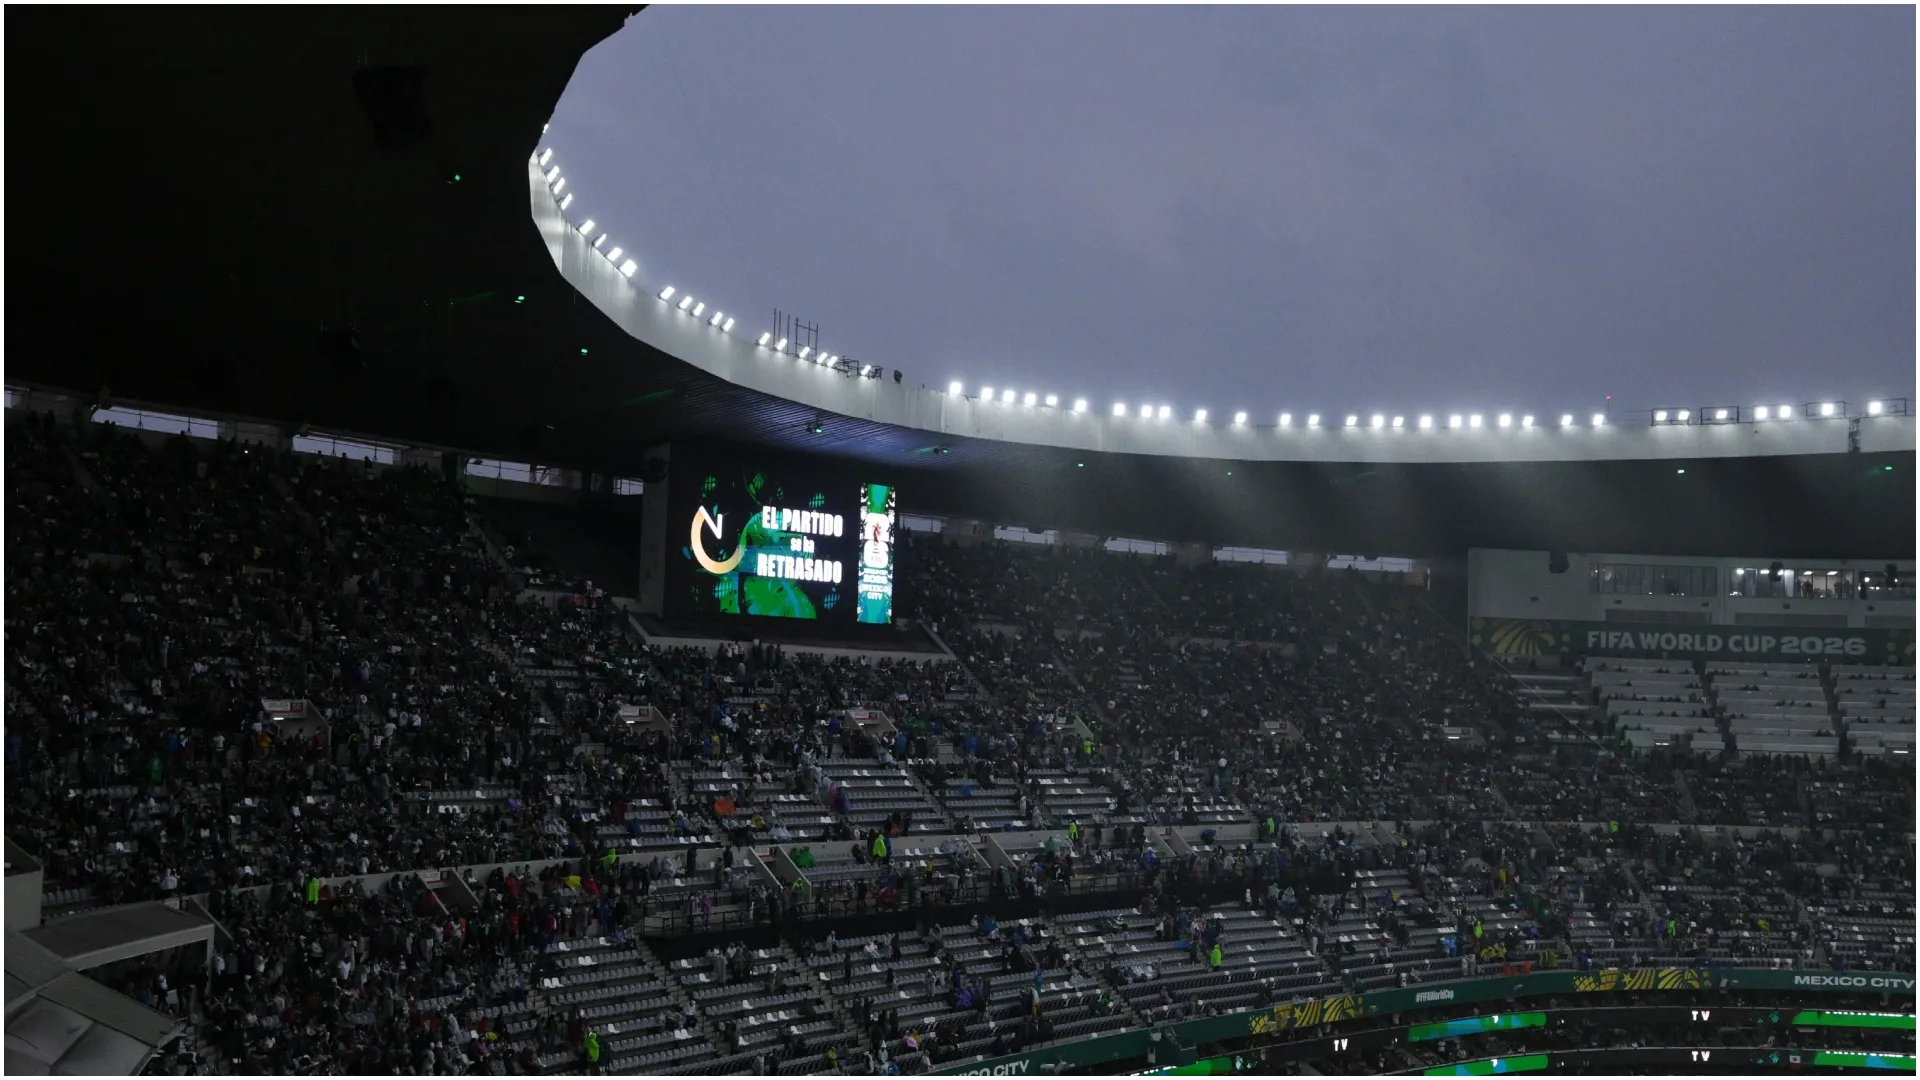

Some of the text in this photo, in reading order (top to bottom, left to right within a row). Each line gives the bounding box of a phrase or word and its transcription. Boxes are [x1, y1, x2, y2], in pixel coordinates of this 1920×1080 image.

[762, 506, 843, 536] EL PARTIDO
[790, 536, 814, 553] se ha
[757, 553, 842, 583] RETRASADO
[867, 592, 882, 600] CITY
[1587, 631, 1867, 655] FIFA WORLD CUP 2026
[1794, 975, 1915, 989] MEXICO CITY
[1415, 989, 1454, 1002] #FIFAWorldCup
[993, 1059, 1030, 1076] CITY
